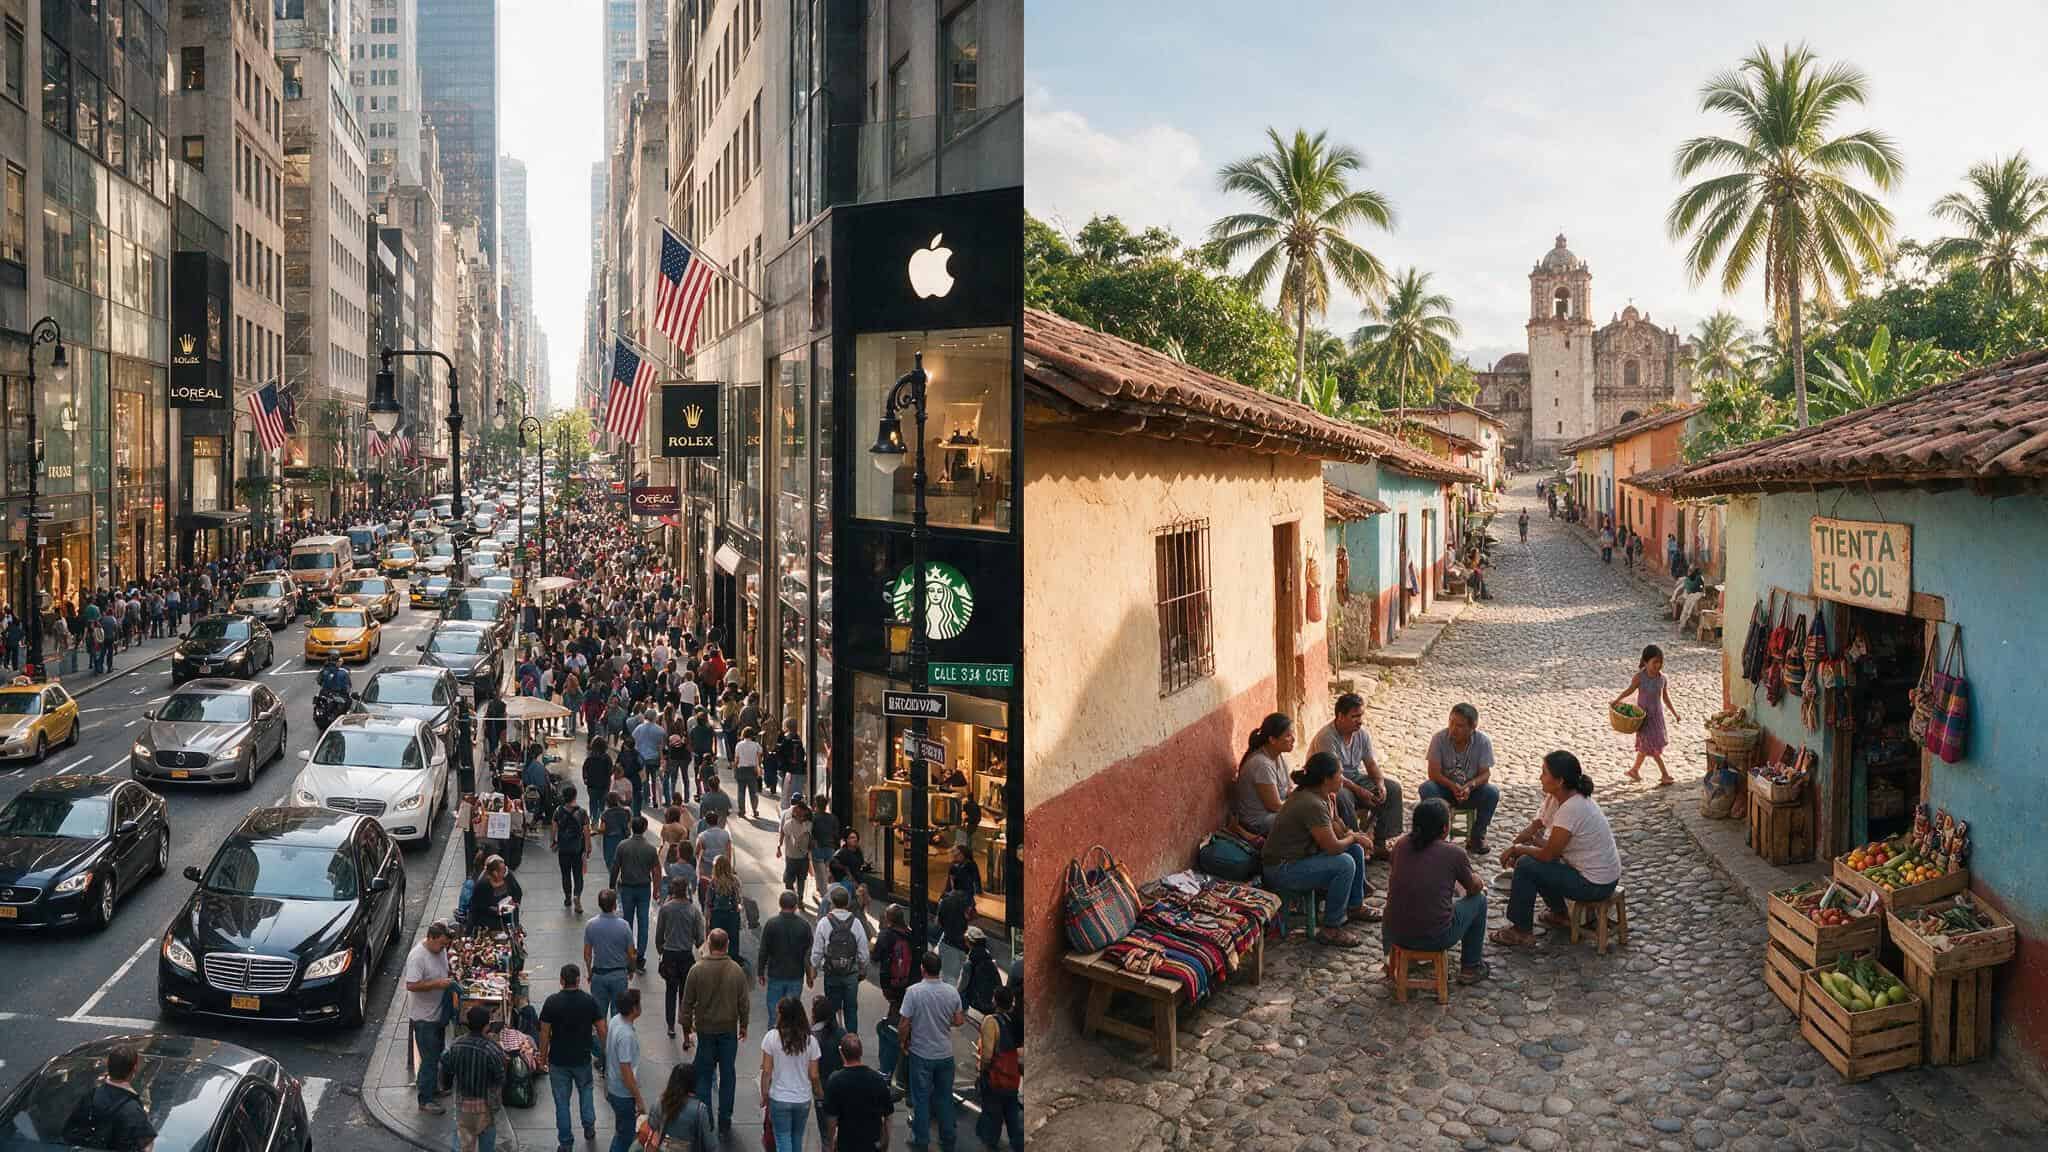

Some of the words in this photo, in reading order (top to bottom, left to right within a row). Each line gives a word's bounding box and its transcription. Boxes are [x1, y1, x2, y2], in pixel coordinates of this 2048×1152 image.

[668, 436, 714, 447] ROLEX
[1816, 526, 1896, 562] TIENTA
[1821, 562, 1841, 592] EL
[1849, 563, 1892, 598] SOL
